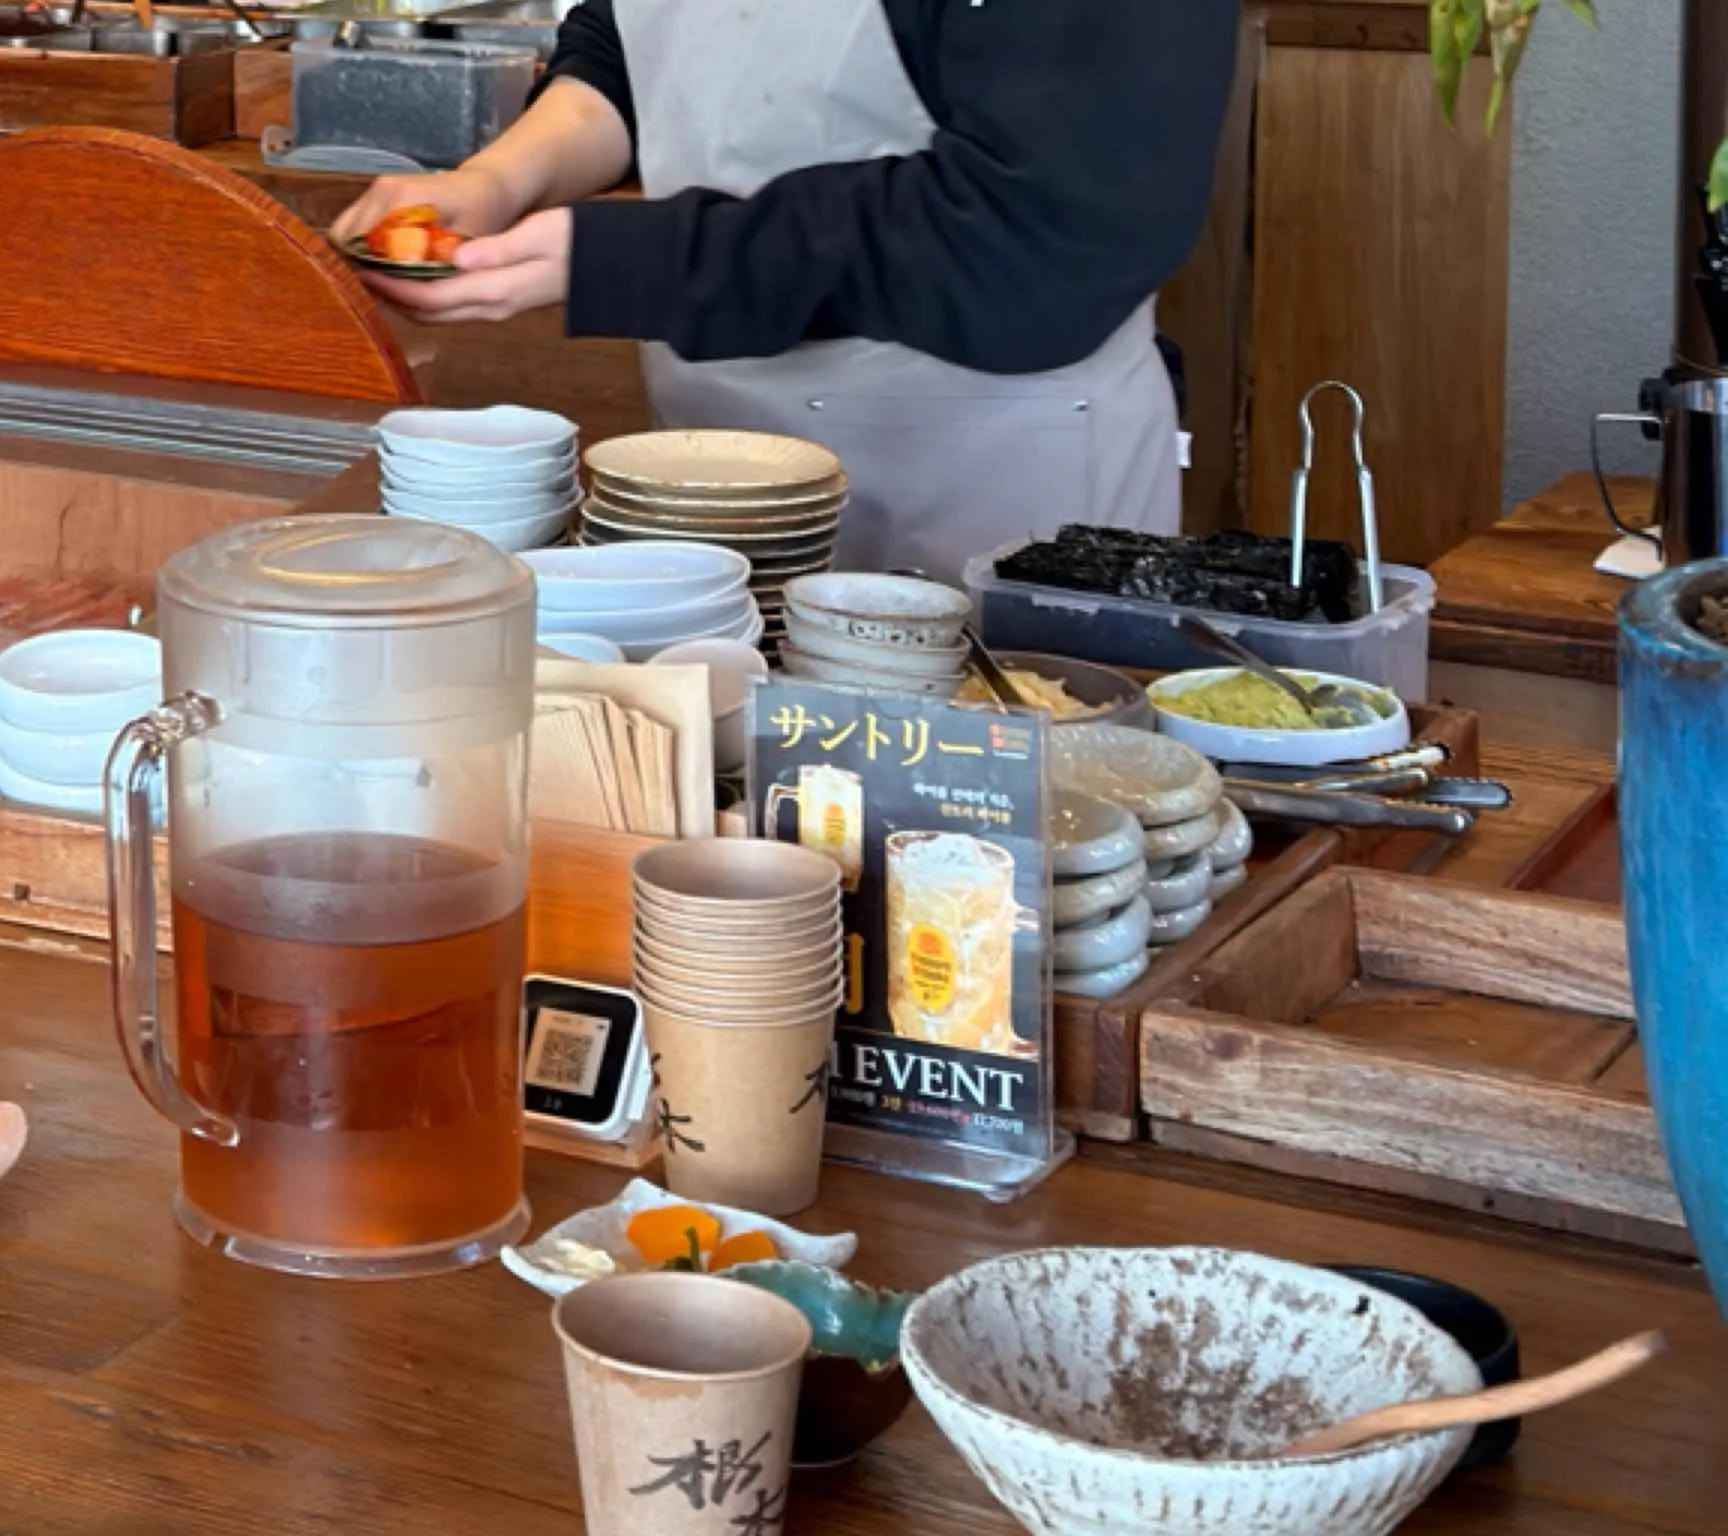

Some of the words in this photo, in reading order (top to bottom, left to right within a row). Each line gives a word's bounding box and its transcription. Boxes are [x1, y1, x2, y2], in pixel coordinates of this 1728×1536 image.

[770, 704, 984, 765] サントリー
[854, 1043, 1024, 1111] EVENT
